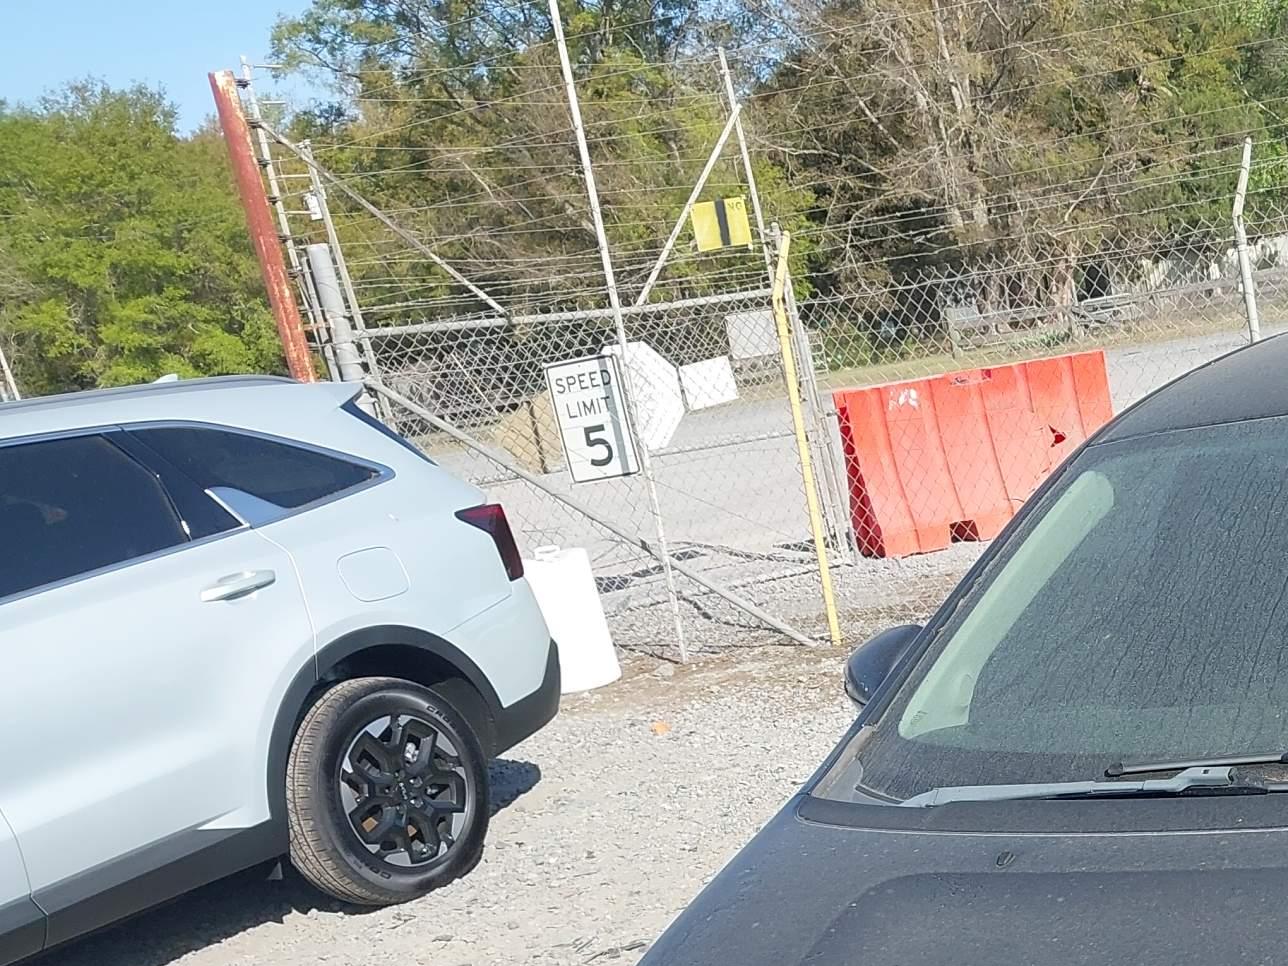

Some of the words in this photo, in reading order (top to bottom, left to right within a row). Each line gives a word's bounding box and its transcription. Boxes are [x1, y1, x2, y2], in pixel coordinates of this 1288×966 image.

[555, 369, 611, 394] SPEED
[566, 395, 610, 419] LIMIT
[583, 424, 613, 467] 5
